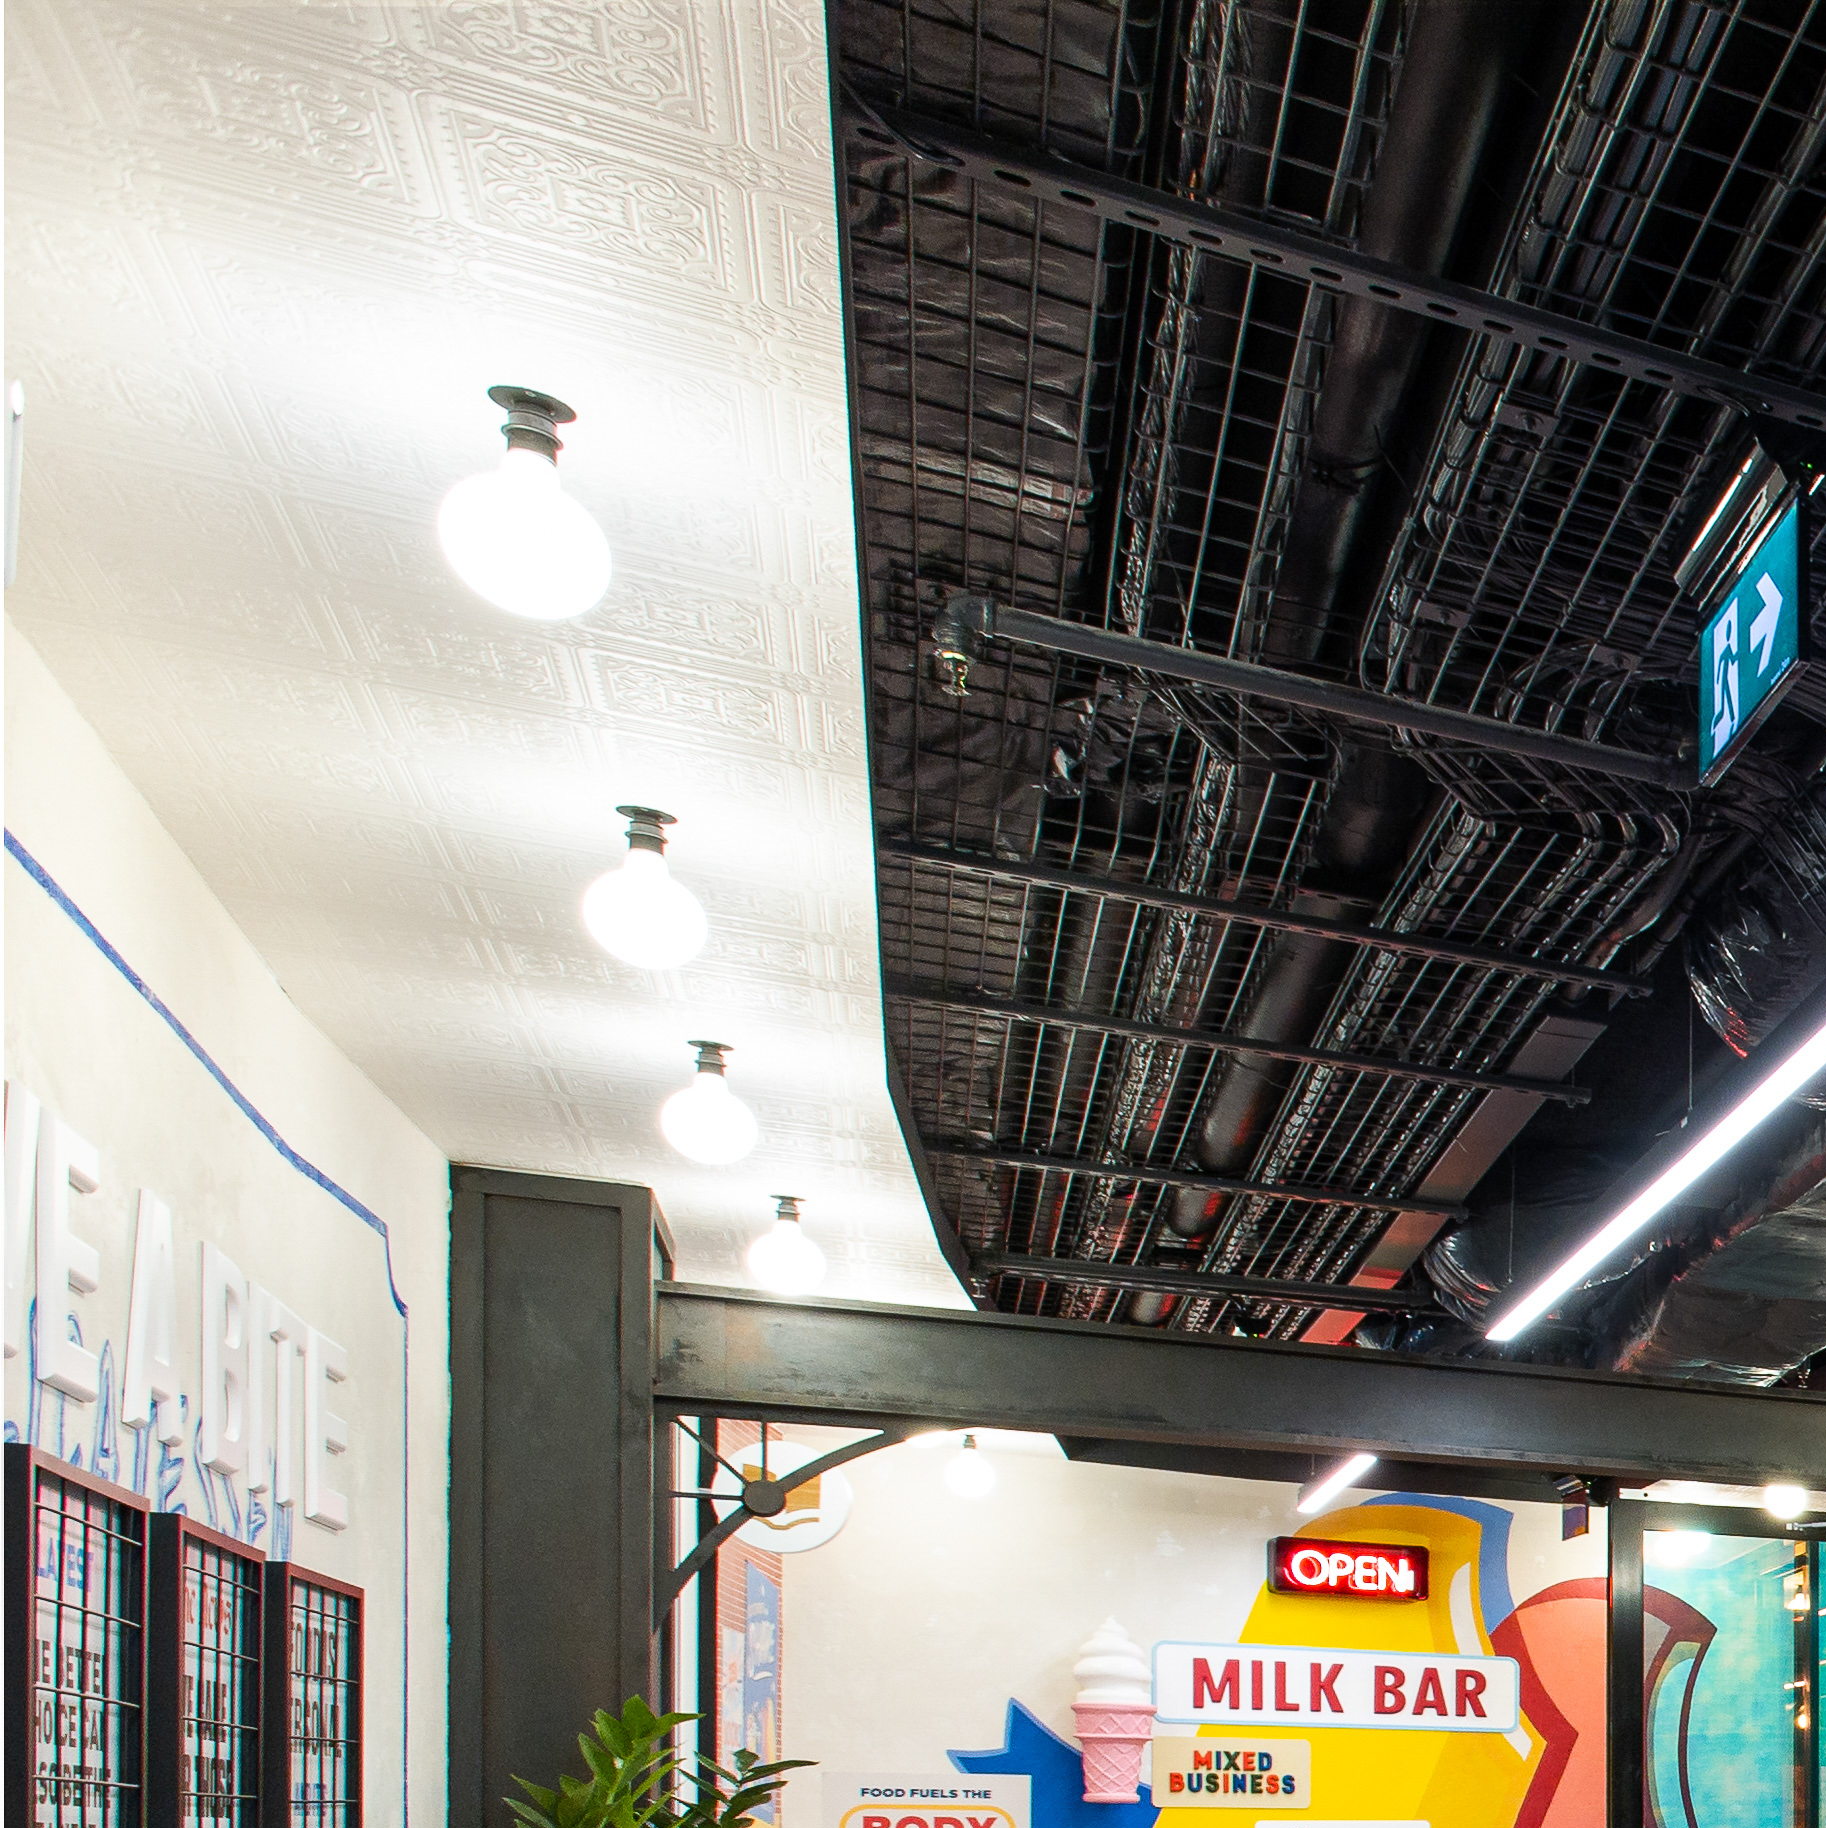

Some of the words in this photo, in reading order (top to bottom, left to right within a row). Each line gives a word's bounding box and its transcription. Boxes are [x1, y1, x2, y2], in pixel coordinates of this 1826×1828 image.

[122, 1187, 182, 1448] A
[199, 1240, 346, 1531] BITE
[1291, 1549, 1414, 1593] OPEN
[1193, 1657, 1345, 1714] MILK
[1373, 1665, 1488, 1719] BAR
[1193, 1750, 1273, 1772] MIXED
[860, 1787, 906, 1798] FOOD
[909, 1788, 959, 1799] FUELS
[963, 1789, 993, 1799] THE
[1169, 1772, 1296, 1795] BUSINESS
